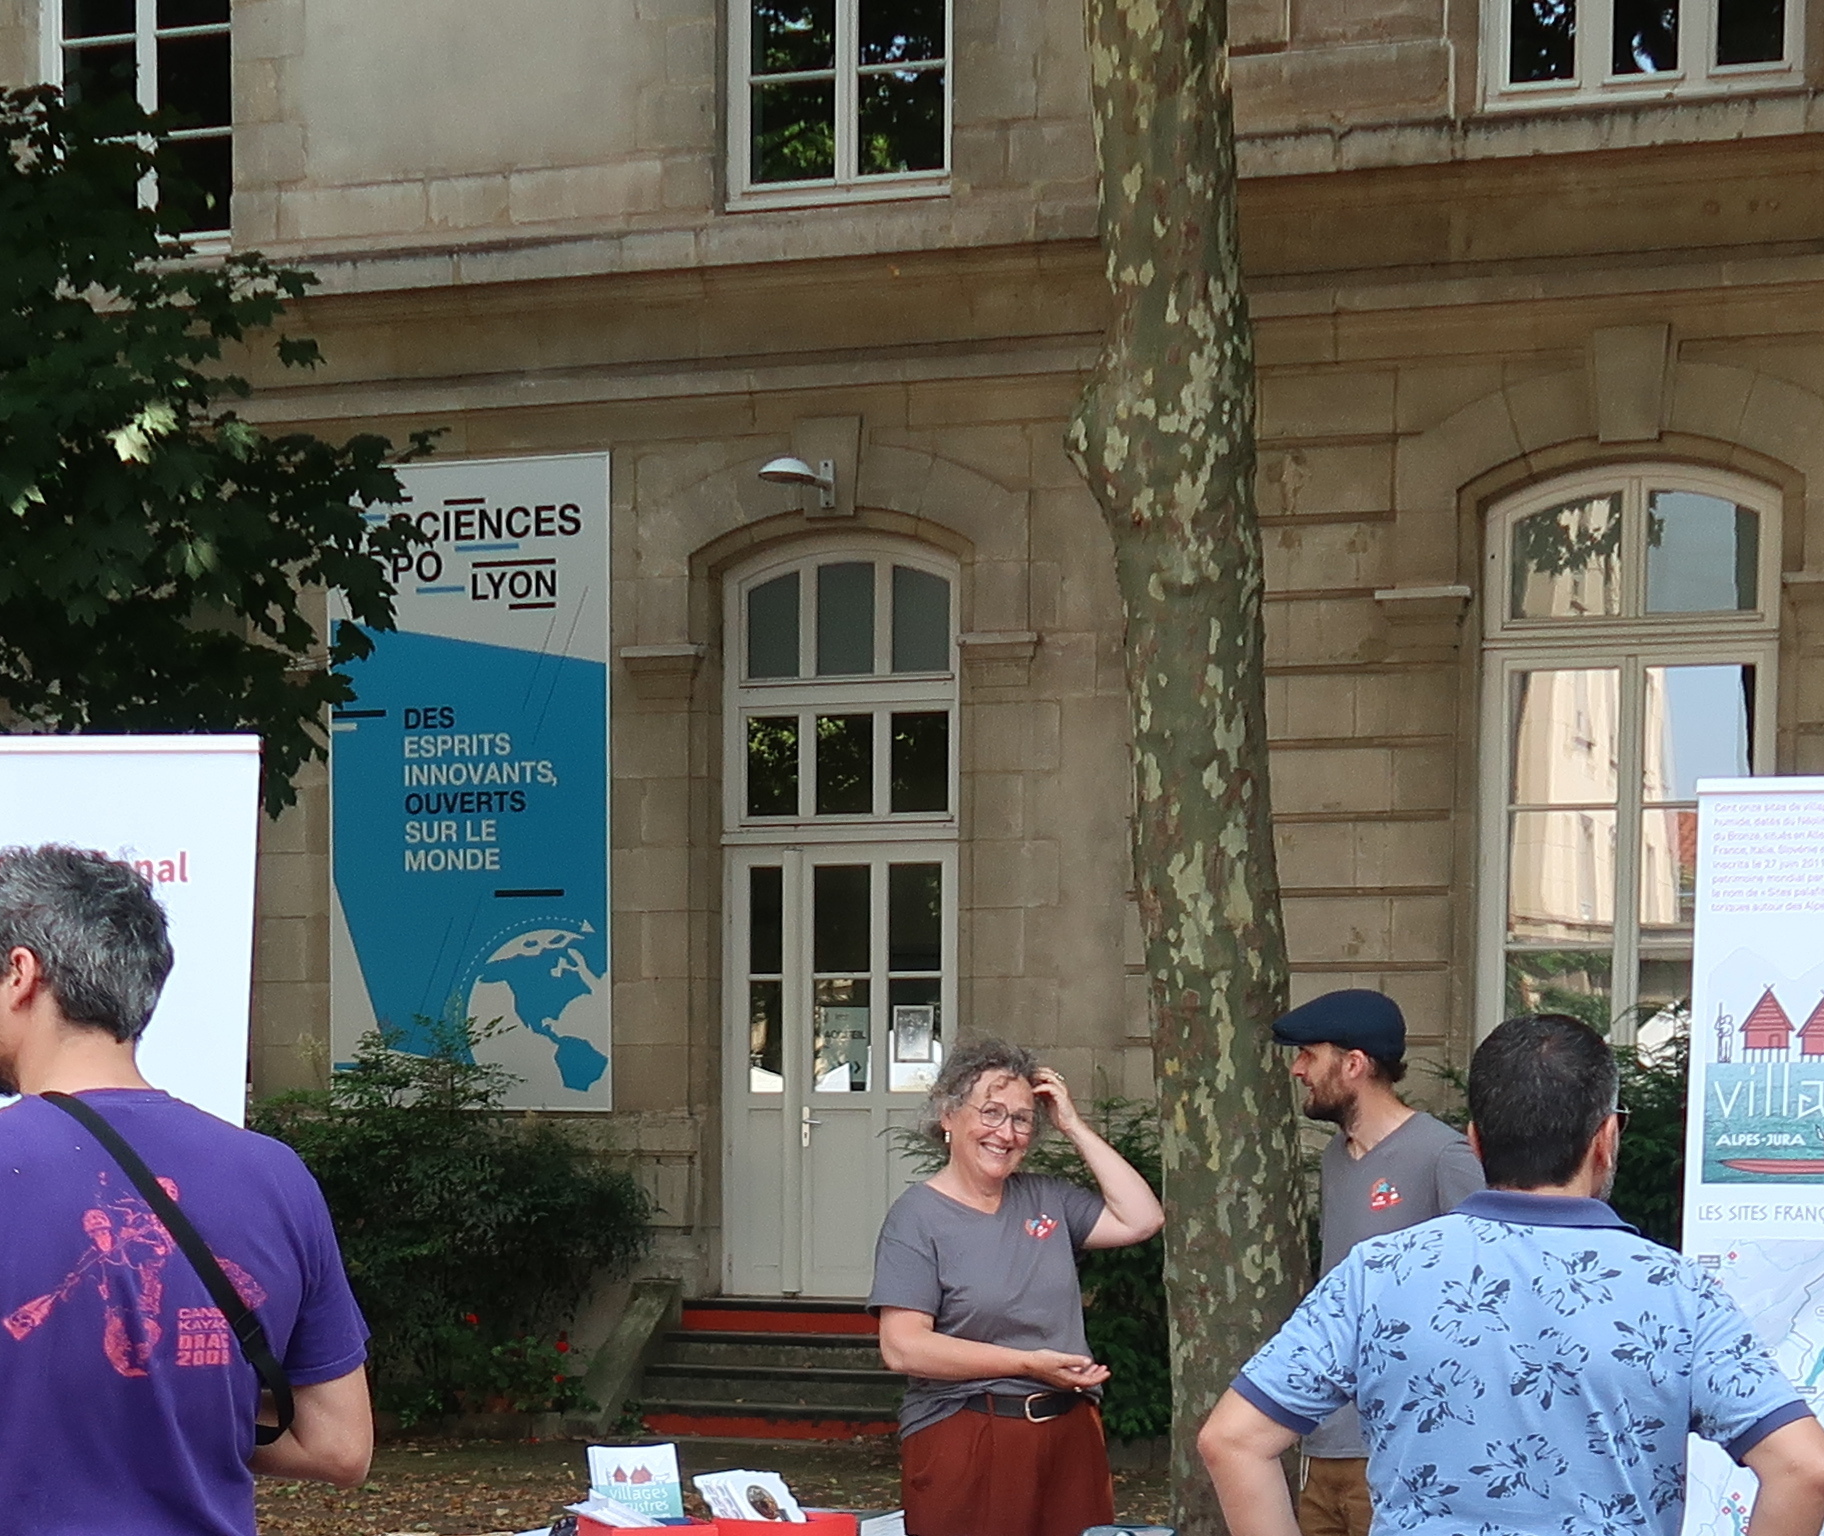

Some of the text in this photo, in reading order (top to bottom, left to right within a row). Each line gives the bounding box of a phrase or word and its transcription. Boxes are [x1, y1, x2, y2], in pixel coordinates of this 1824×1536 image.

[392, 551, 557, 600] PO LYON
[403, 707, 455, 730] DES
[403, 733, 512, 759] ESPRITS
[403, 760, 558, 787] INNOVANTS,
[404, 791, 527, 815] OUVERTS
[404, 819, 497, 843] SUR LE
[404, 849, 501, 872] MONDE
[1697, 1205, 1723, 1221] LES
[1728, 1206, 1768, 1222] SITES
[608, 1484, 669, 1501] villages
